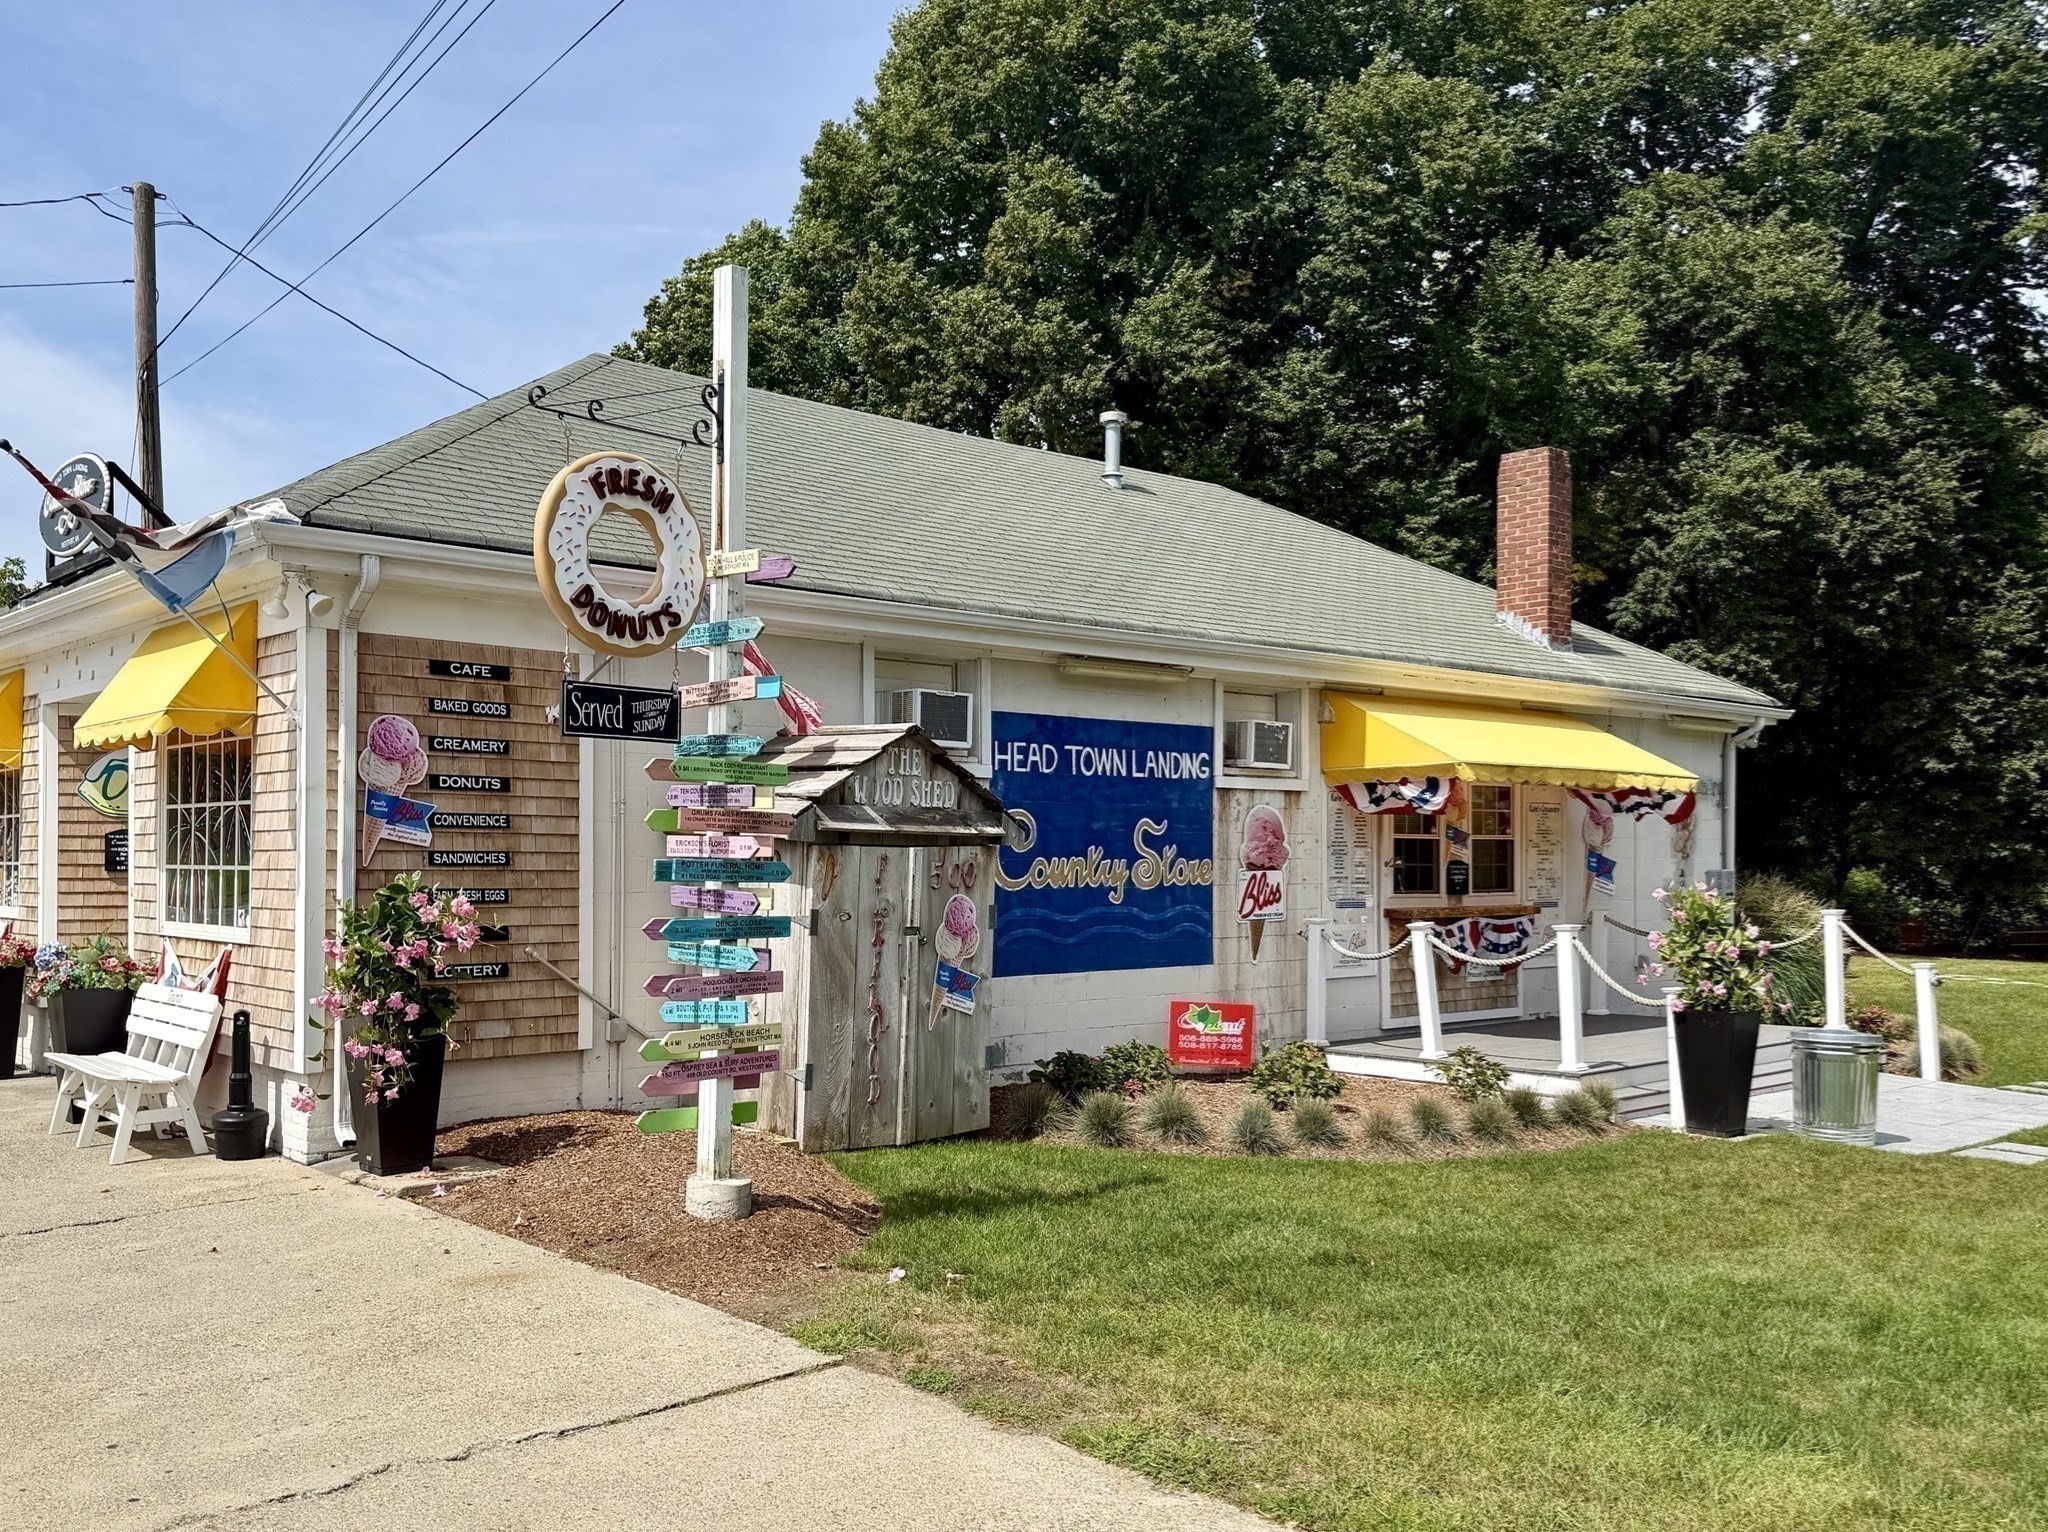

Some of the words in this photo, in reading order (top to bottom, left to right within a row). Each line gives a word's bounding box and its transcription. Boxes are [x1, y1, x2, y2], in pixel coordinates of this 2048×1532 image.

[62, 465, 73, 477] TOWN
[73, 463, 88, 473] LANDING
[588, 467, 675, 514] FRESH
[722, 556, 733, 564] HALL
[738, 553, 754, 562] POLICE
[570, 584, 682, 641] DONUTS
[702, 625, 715, 634] SEA
[450, 663, 492, 677] CAFE
[434, 699, 469, 713] BAKED
[472, 702, 507, 716] GOODS
[569, 691, 623, 729] Served
[631, 698, 671, 713] THURSDAY
[632, 714, 667, 733] SUNDAY
[433, 738, 506, 752] CREAMERY
[737, 763, 768, 771] RESTAURANT
[886, 747, 922, 777] THE
[994, 741, 1058, 773] HEAD
[1064, 745, 1127, 777] TOWN
[1132, 749, 1210, 779] LANDING
[439, 776, 501, 790] DONUTS
[711, 787, 744, 795] RESTAURANT
[910, 779, 955, 809] SHED
[433, 814, 507, 827] CONVENIENCE
[714, 810, 735, 818] FAMILY
[735, 811, 774, 819] RESTAURANT
[675, 839, 707, 847] ERICKSON'S
[708, 840, 730, 848] FLORIST
[433, 853, 506, 864] SANDWICHES
[994, 808, 1129, 904] Country
[1131, 817, 1213, 891] Store
[680, 860, 709, 869] POTTER
[711, 861, 743, 870] FUNERAL
[745, 863, 765, 871] HOME
[484, 890, 505, 901] EGGS
[1238, 872, 1282, 919] Bliss
[740, 919, 766, 927] CLOSET
[435, 964, 502, 978] LOTTERY
[703, 978, 738, 986] NOQUOCHOKE
[739, 975, 766, 983] ORCHARDS
[675, 1004, 702, 1012] BOUTIQUE
[691, 1041, 706, 1049] JOHN
[746, 1034, 773, 1043] WESTPORT
[700, 1030, 744, 1042] HORSENECK
[746, 1028, 770, 1037] BEACH
[1178, 1034, 1243, 1043] 508-889-5968
[1172, 1048, 1209, 1056] Commercial
[1178, 1041, 1243, 1050] 508-617-8785
[681, 1062, 705, 1072] OSPREY
[706, 1061, 718, 1069] SEA
[718, 1060, 724, 1068] &
[724, 1058, 740, 1067] SURF
[740, 1054, 778, 1065] ADVENTURES
[1178, 1055, 1210, 1065] Committed
[1211, 1057, 1220, 1065] To
[1220, 1058, 1241, 1067] Quality
[662, 1070, 673, 1079] 150
[673, 1069, 681, 1077] FT
[696, 1070, 707, 1078] OLD
[707, 1068, 728, 1077] COUNTY
[738, 1063, 765, 1072] WESTPORT
